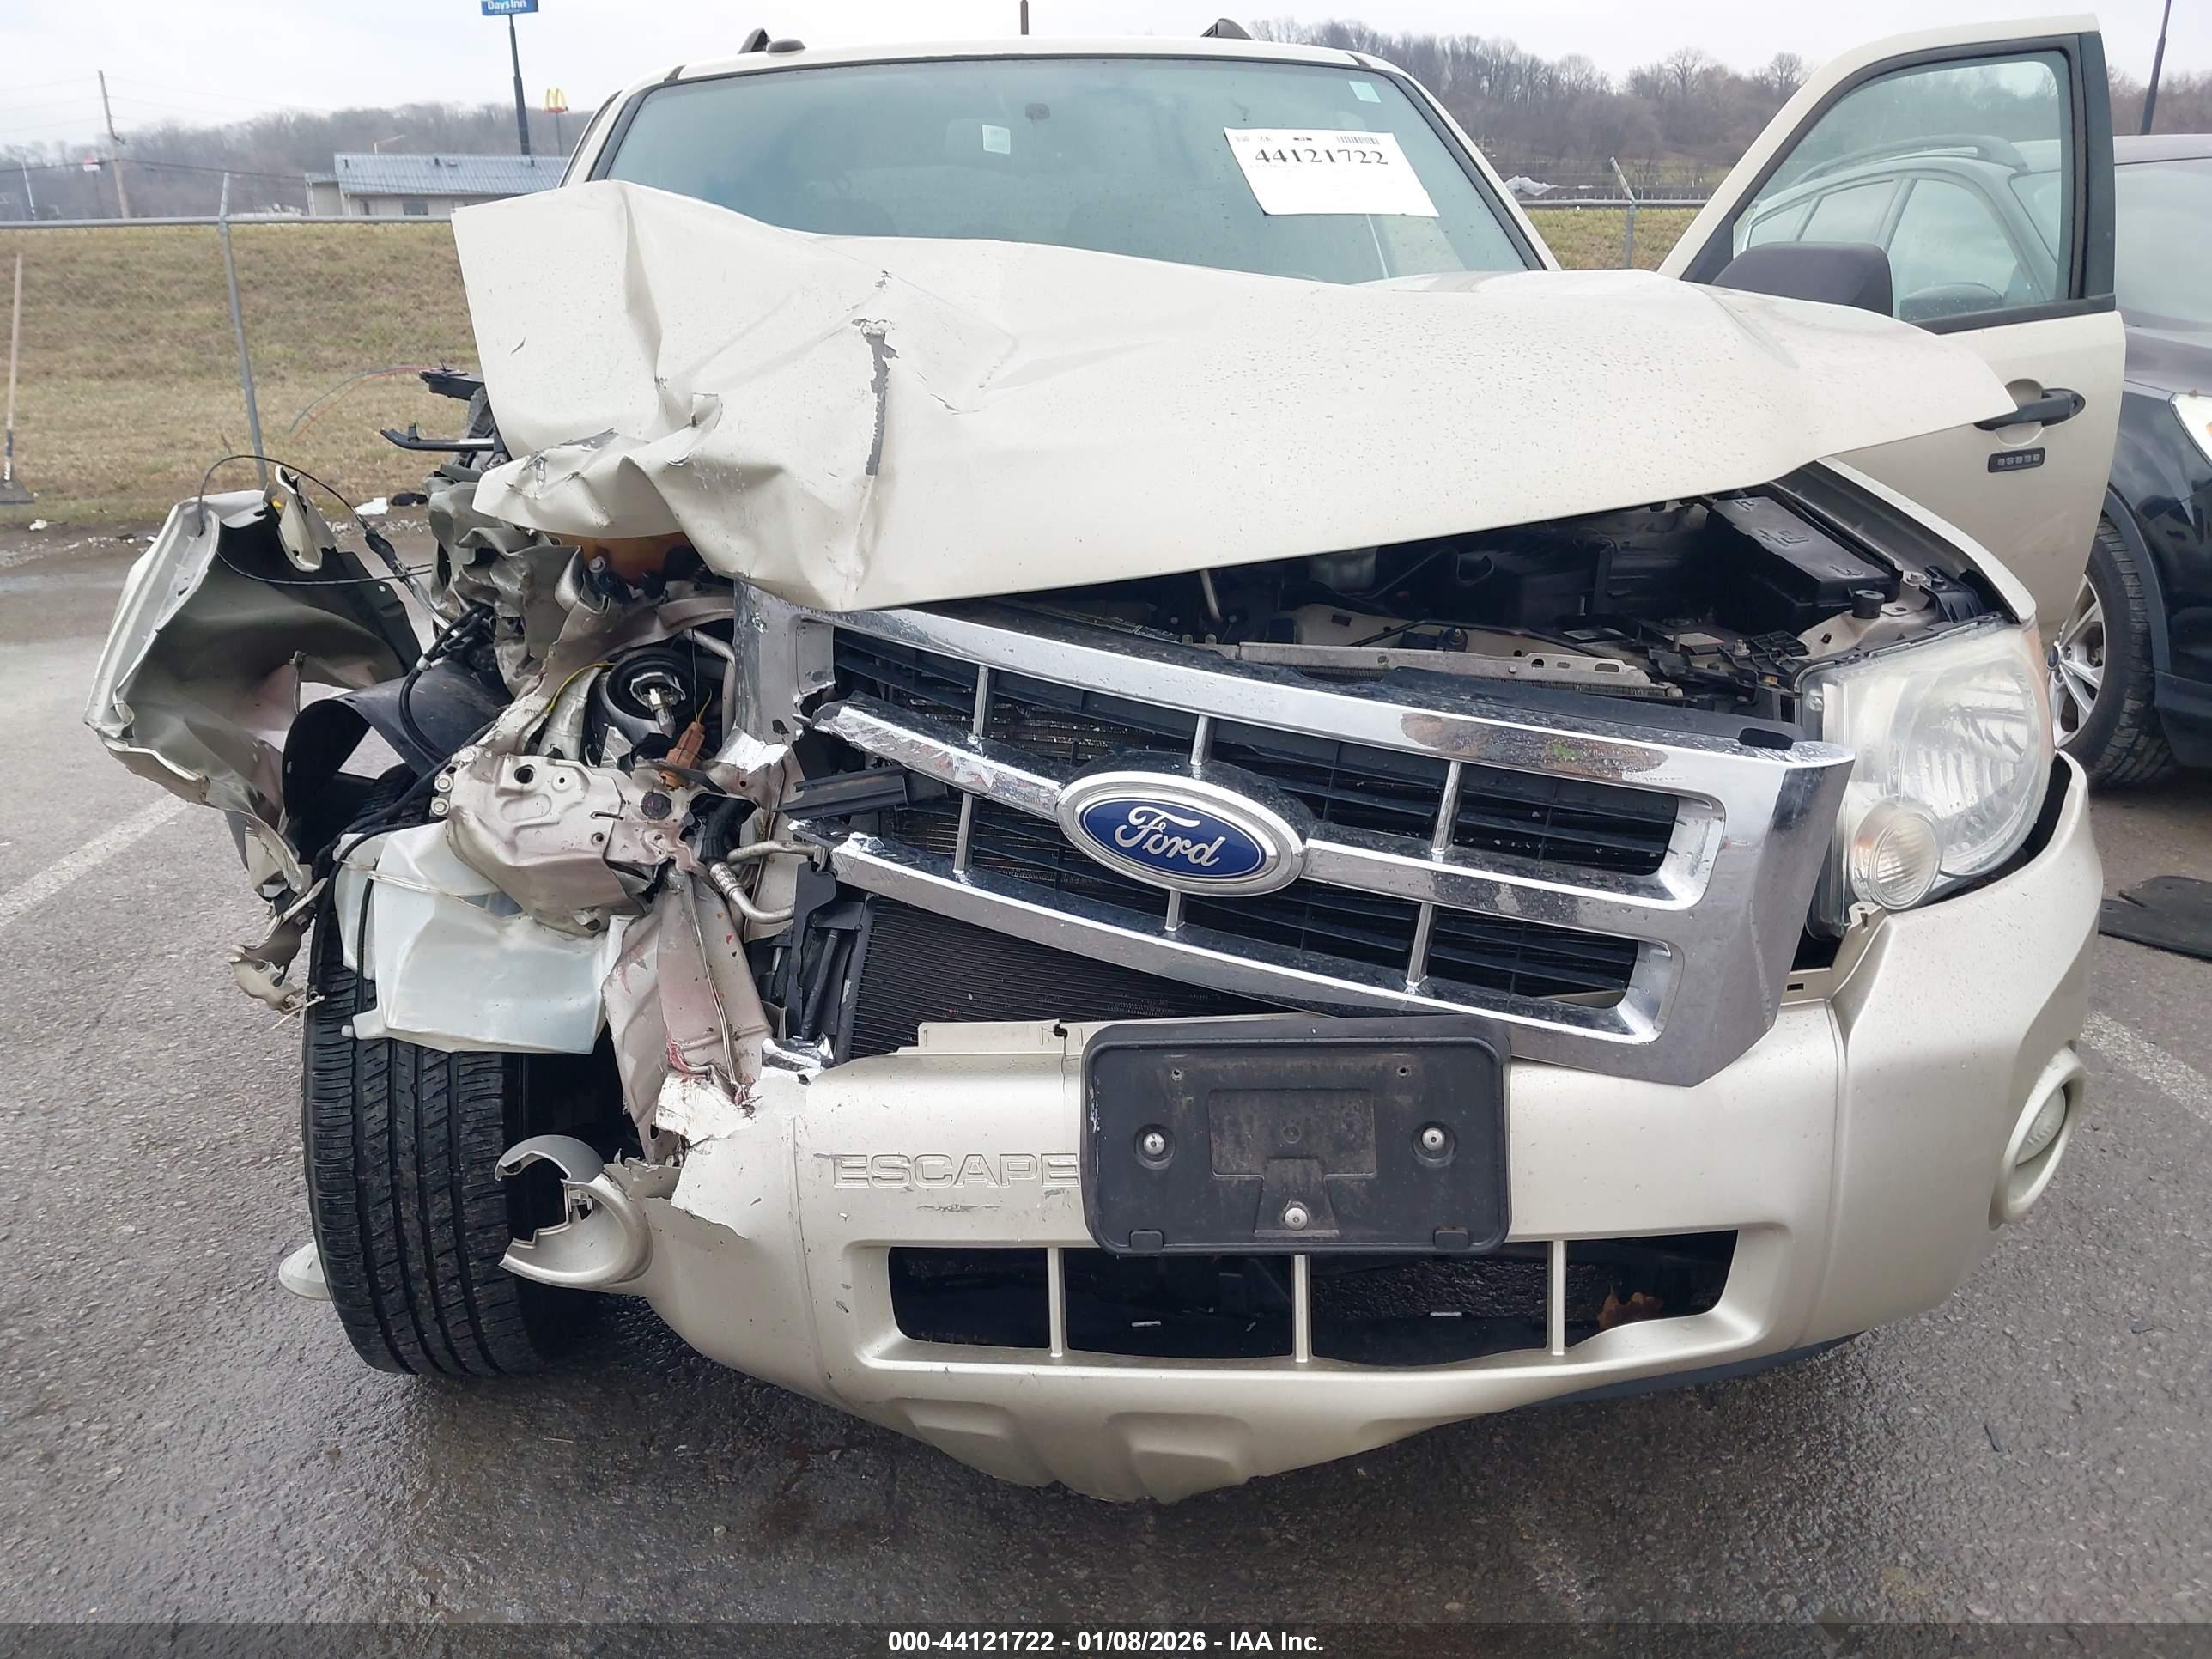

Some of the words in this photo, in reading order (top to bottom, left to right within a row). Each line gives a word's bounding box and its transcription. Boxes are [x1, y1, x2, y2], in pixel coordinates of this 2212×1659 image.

[487, 0, 510, 10] Days
[1255, 149, 1388, 165] 44121722
[1115, 806, 1226, 866] Ford
[833, 1153, 1079, 1188] ESCAPE
